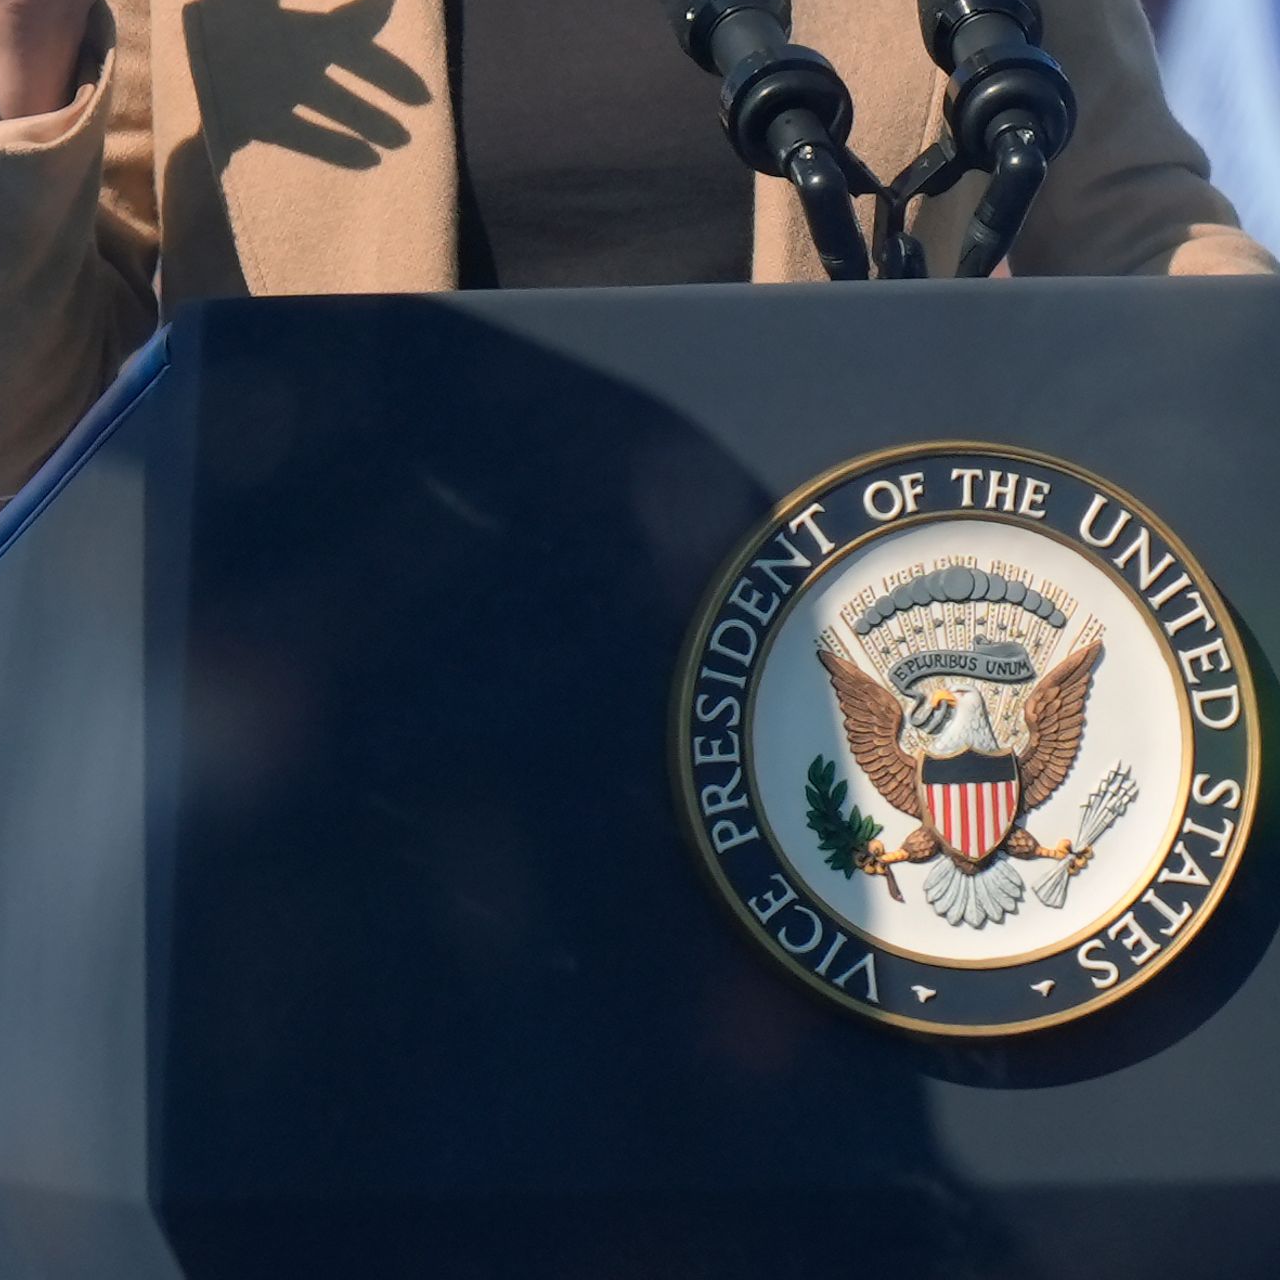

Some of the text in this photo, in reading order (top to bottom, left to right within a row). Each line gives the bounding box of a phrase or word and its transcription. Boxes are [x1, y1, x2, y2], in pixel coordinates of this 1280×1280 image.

[693, 467, 1243, 1005] VICE PRESIDENT OF THE UNITED STATES
[894, 654, 1030, 681] E PLURIBUS UNUM
